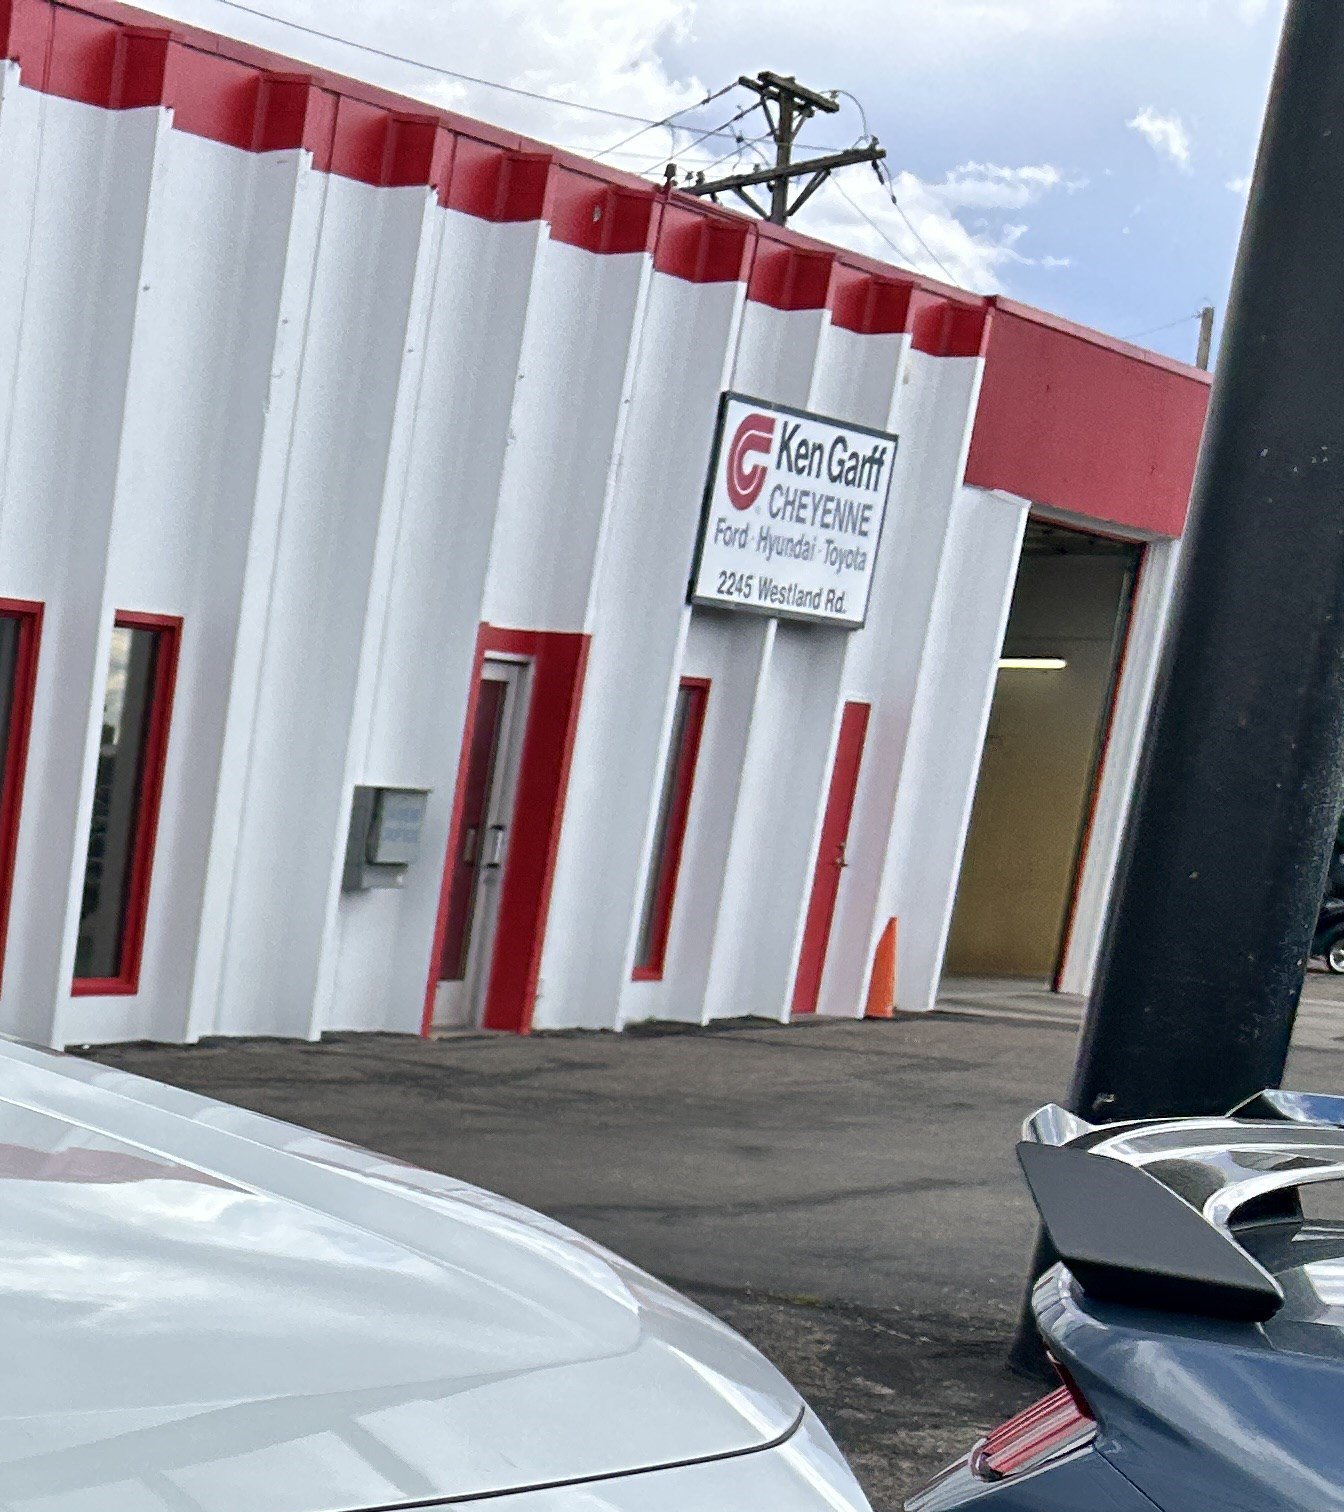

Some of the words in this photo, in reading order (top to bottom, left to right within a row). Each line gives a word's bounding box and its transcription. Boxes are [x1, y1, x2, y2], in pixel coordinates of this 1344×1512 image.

[776, 420, 824, 478] Ken
[828, 435, 887, 492] Garff
[769, 483, 874, 537] CHEYENNE
[714, 517, 750, 549] Ford
[756, 525, 817, 561] Hyundai
[823, 537, 868, 575] Toyota
[716, 569, 754, 599] 2245
[758, 576, 823, 610] Westland
[823, 588, 848, 614] Rd.
